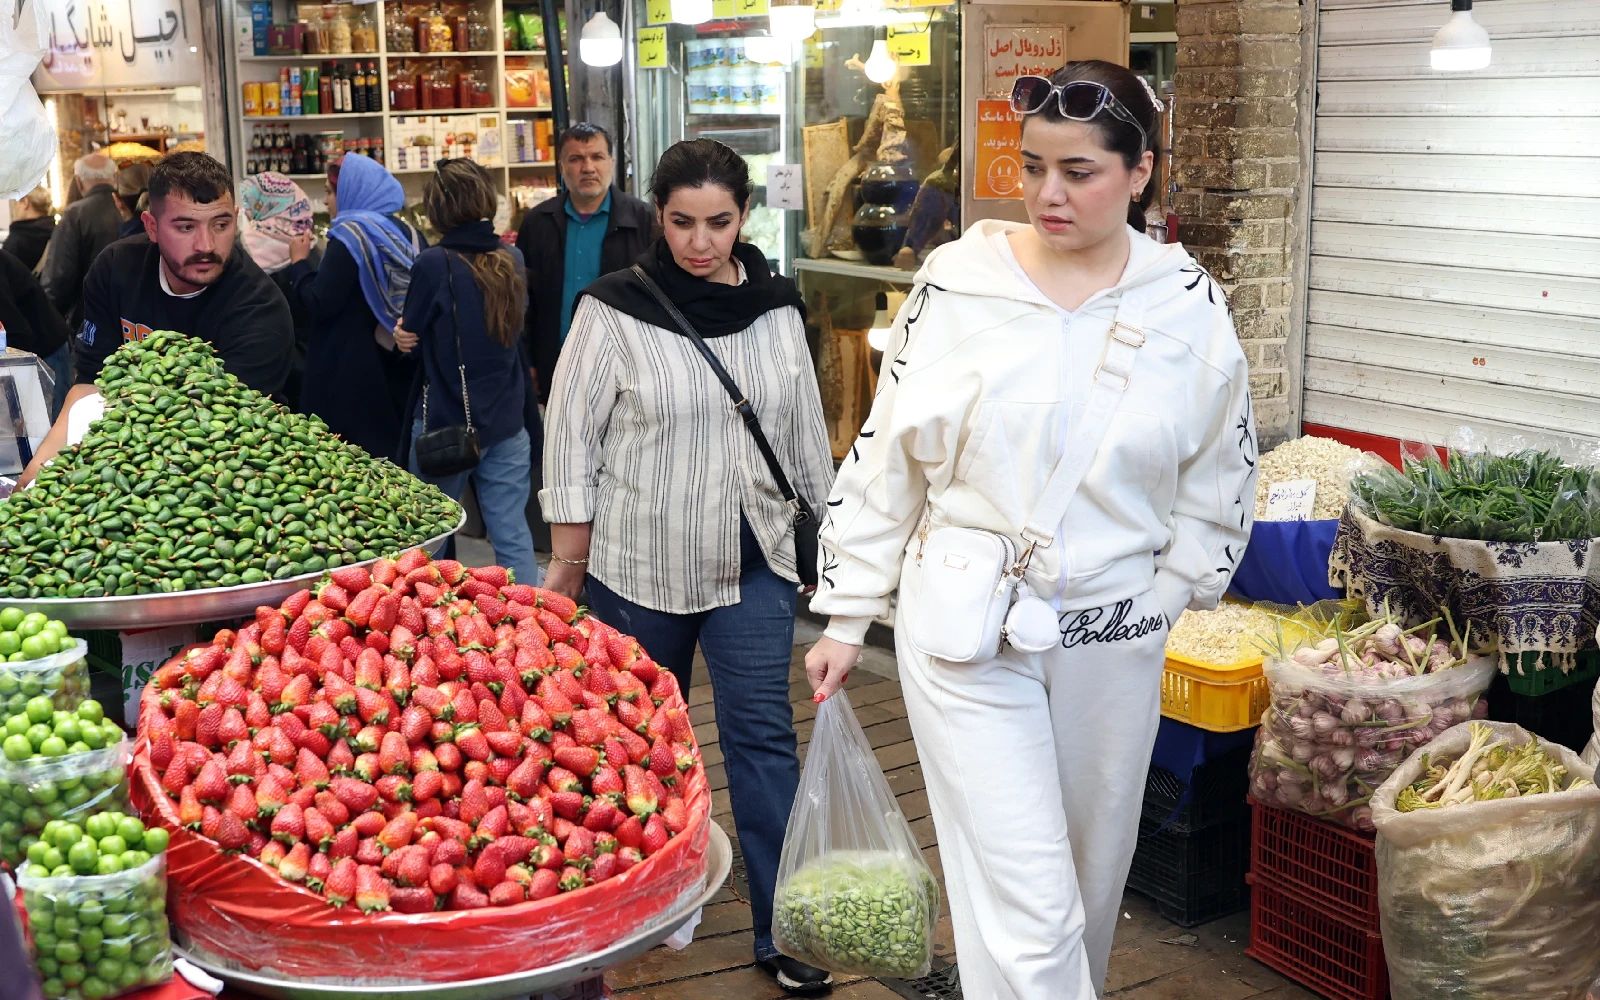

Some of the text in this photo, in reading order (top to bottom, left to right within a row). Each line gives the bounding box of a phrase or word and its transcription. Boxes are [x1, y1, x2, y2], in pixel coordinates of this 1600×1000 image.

[990, 38, 1061, 57] ژل رویال اصل
[995, 63, 1019, 77] است
[980, 111, 1004, 122] ماسک
[1006, 111, 1013, 124] با
